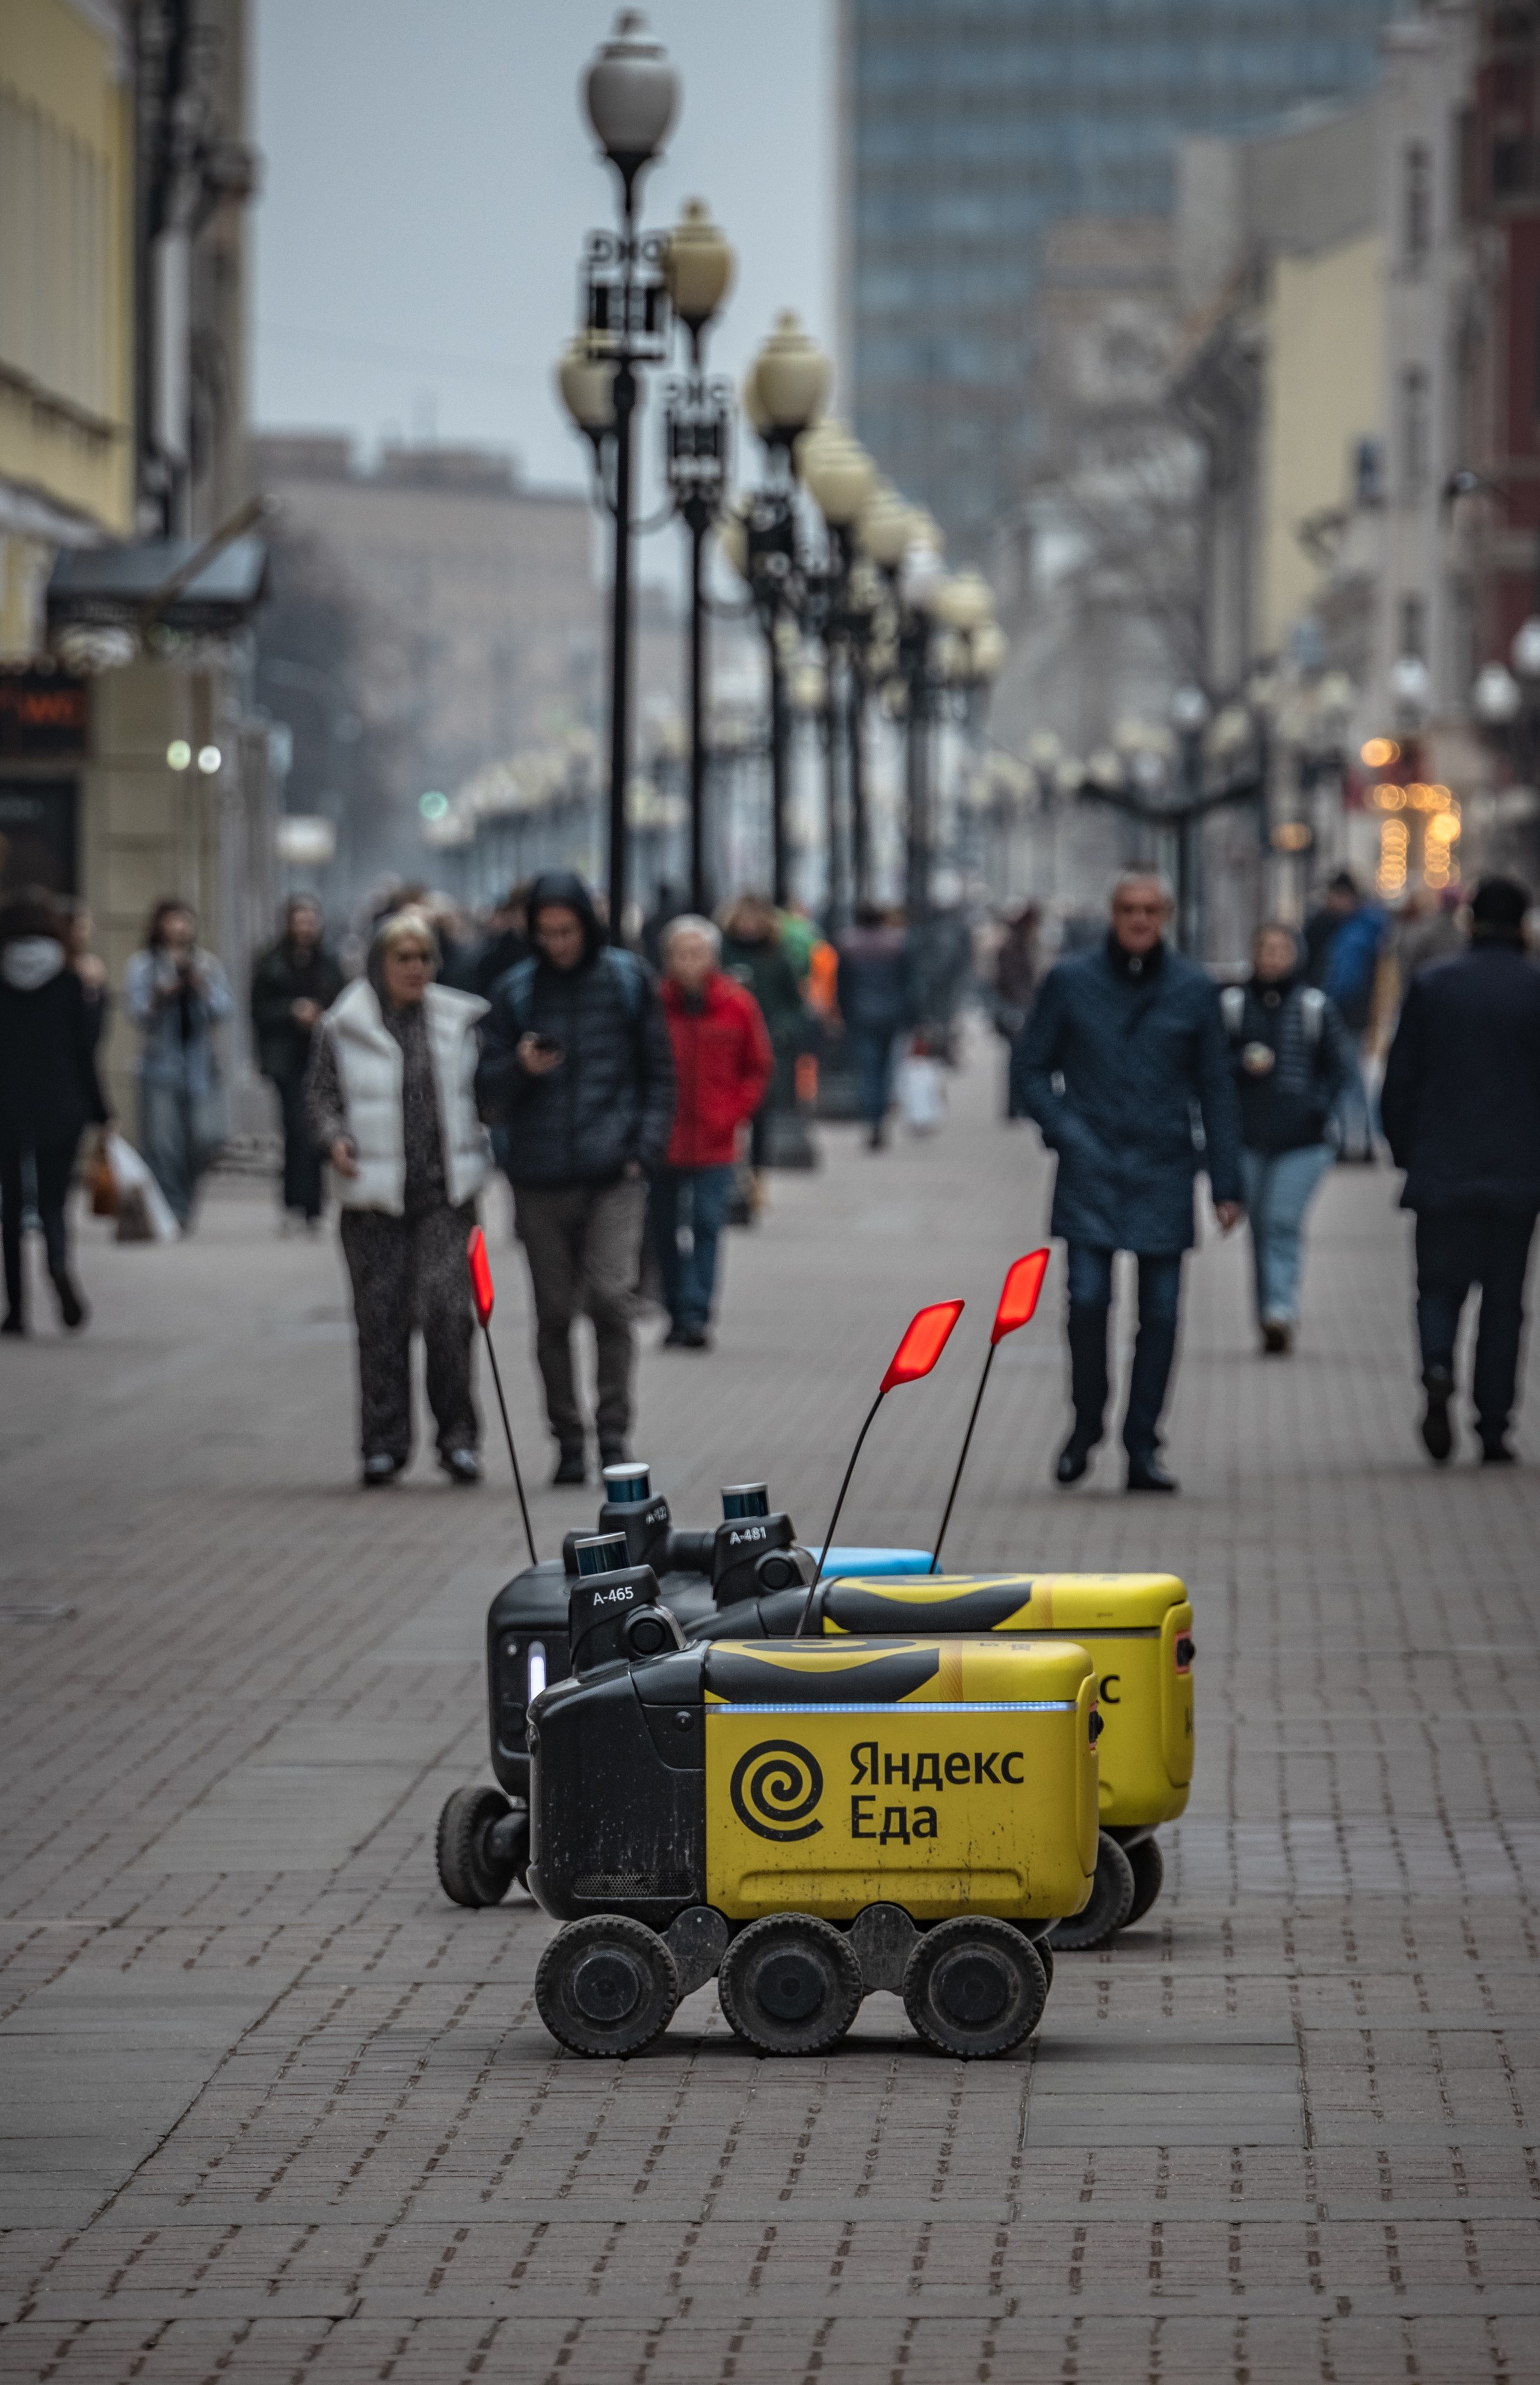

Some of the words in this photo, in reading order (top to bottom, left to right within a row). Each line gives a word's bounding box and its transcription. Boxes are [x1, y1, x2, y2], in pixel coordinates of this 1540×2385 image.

[730, 1526, 766, 1545] A-481
[593, 1586, 634, 1606] A-465
[849, 1741, 1024, 1792] Яндекс
[851, 1795, 938, 1845] Еда
